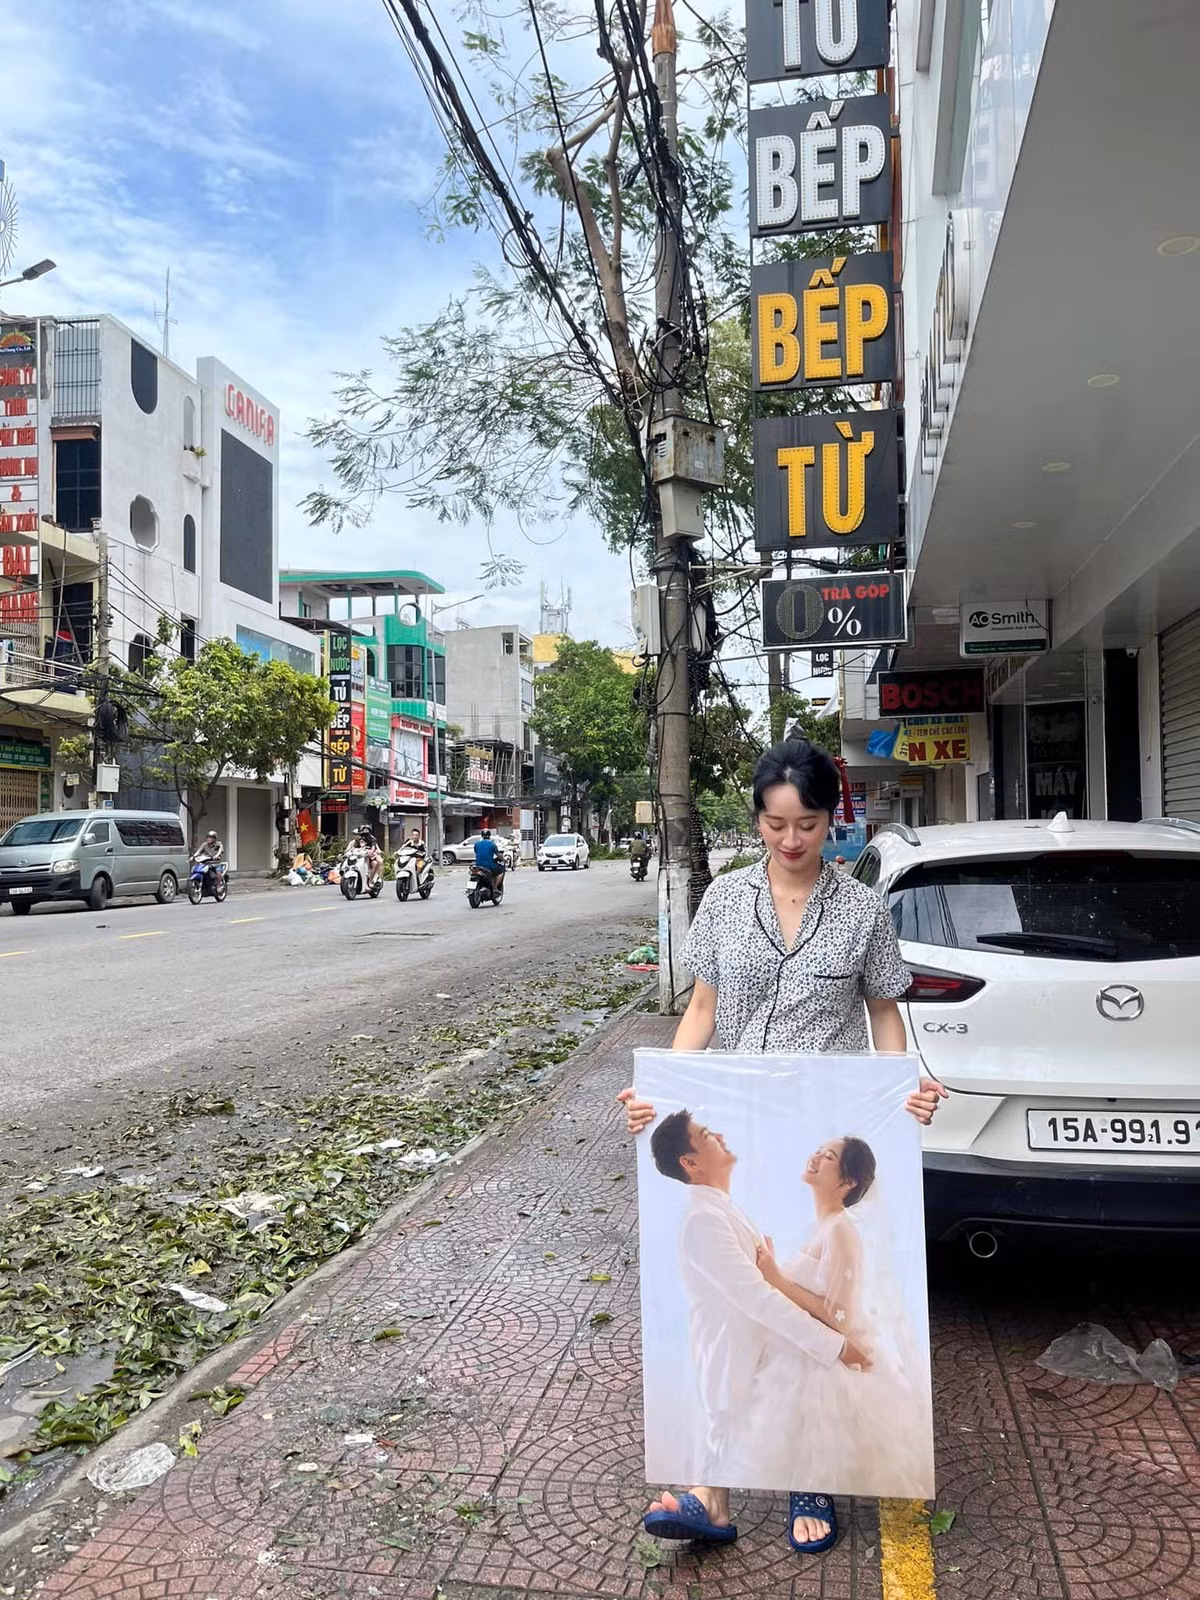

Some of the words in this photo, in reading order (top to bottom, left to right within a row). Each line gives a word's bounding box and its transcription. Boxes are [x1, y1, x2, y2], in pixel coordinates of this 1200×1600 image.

[755, 100, 886, 228] BẾP
[758, 257, 889, 384] BẾP
[225, 384, 275, 447] CANIFA
[777, 420, 875, 537] TỪ
[856, 580, 889, 599] GÓP
[333, 637, 347, 652] LỌC
[331, 654, 350, 671] NƯỚC
[334, 681, 346, 700] TỦ
[934, 739, 967, 760] XE
[923, 1022, 968, 1034] CX-3
